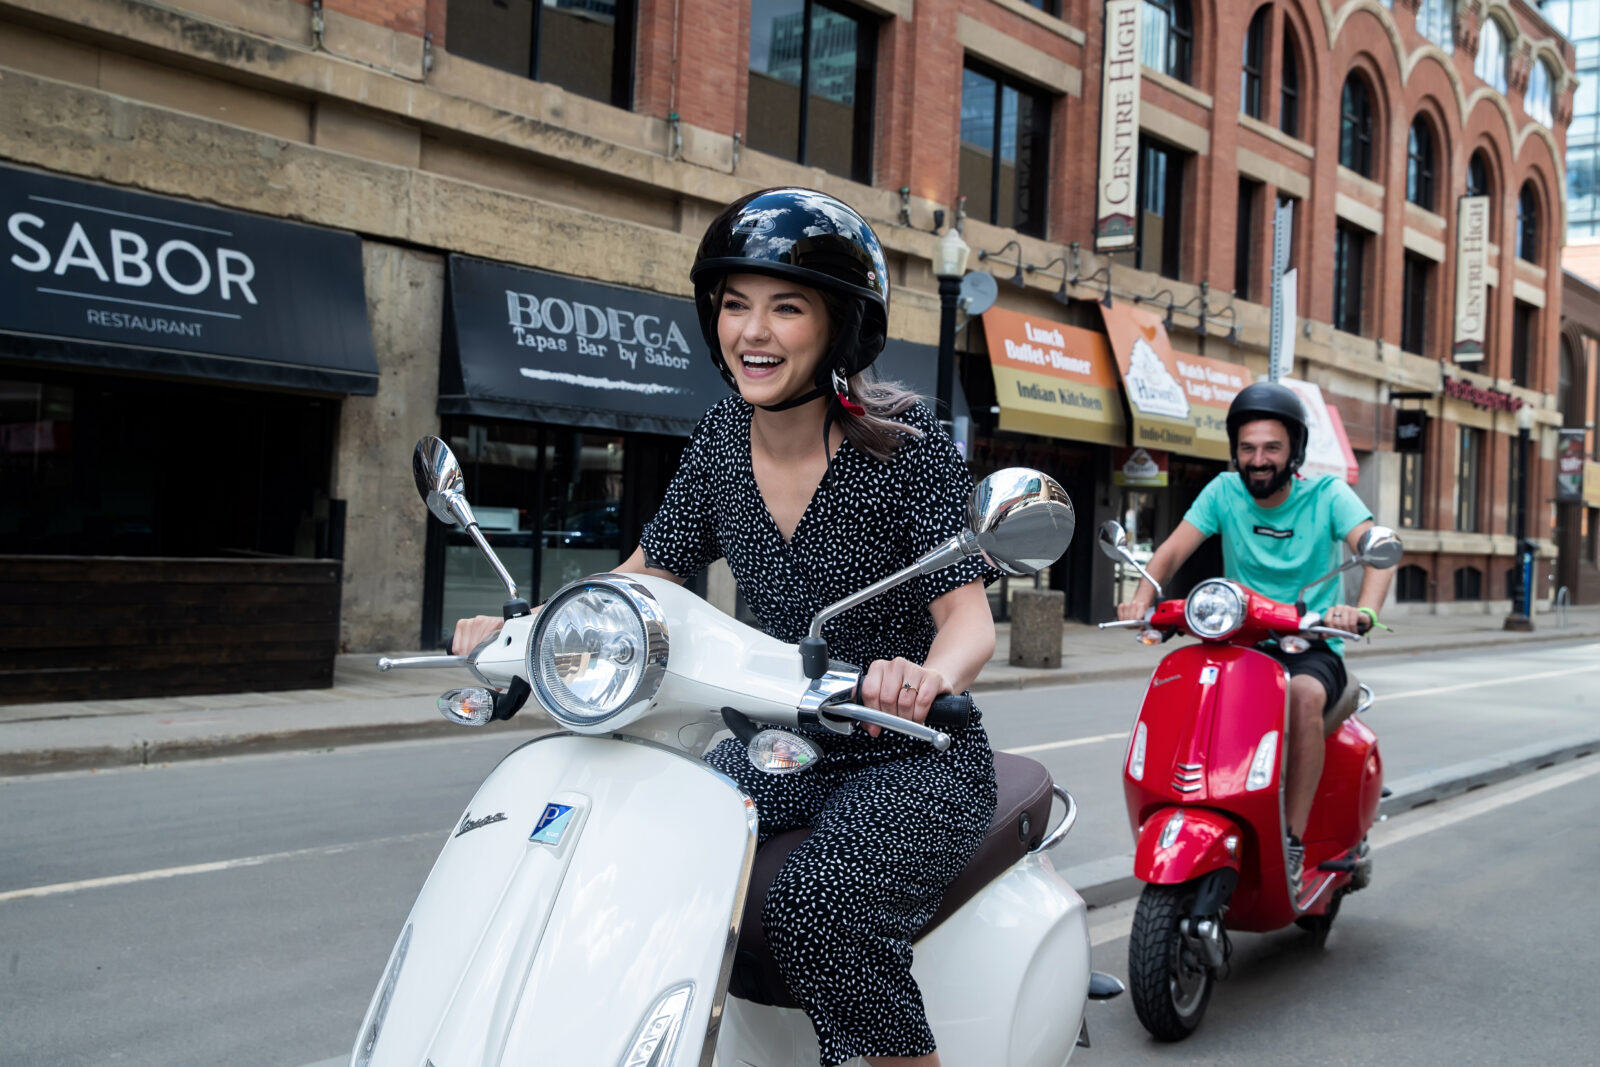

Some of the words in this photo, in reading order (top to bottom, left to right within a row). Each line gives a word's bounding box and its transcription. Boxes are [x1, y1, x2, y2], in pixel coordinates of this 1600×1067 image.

[7, 212, 258, 305] SABOR
[86, 309, 203, 338] RESTAURANT
[505, 290, 691, 354] BODEGA
[1024, 321, 1065, 348] Lunch
[513, 327, 568, 352] Tapas
[576, 335, 608, 357] Bar
[618, 343, 638, 369] by
[645, 348, 690, 370] Sabor
[1016, 380, 1057, 403] Indian
[1058, 387, 1103, 411] Kitchen
[538, 806, 559, 828] P
